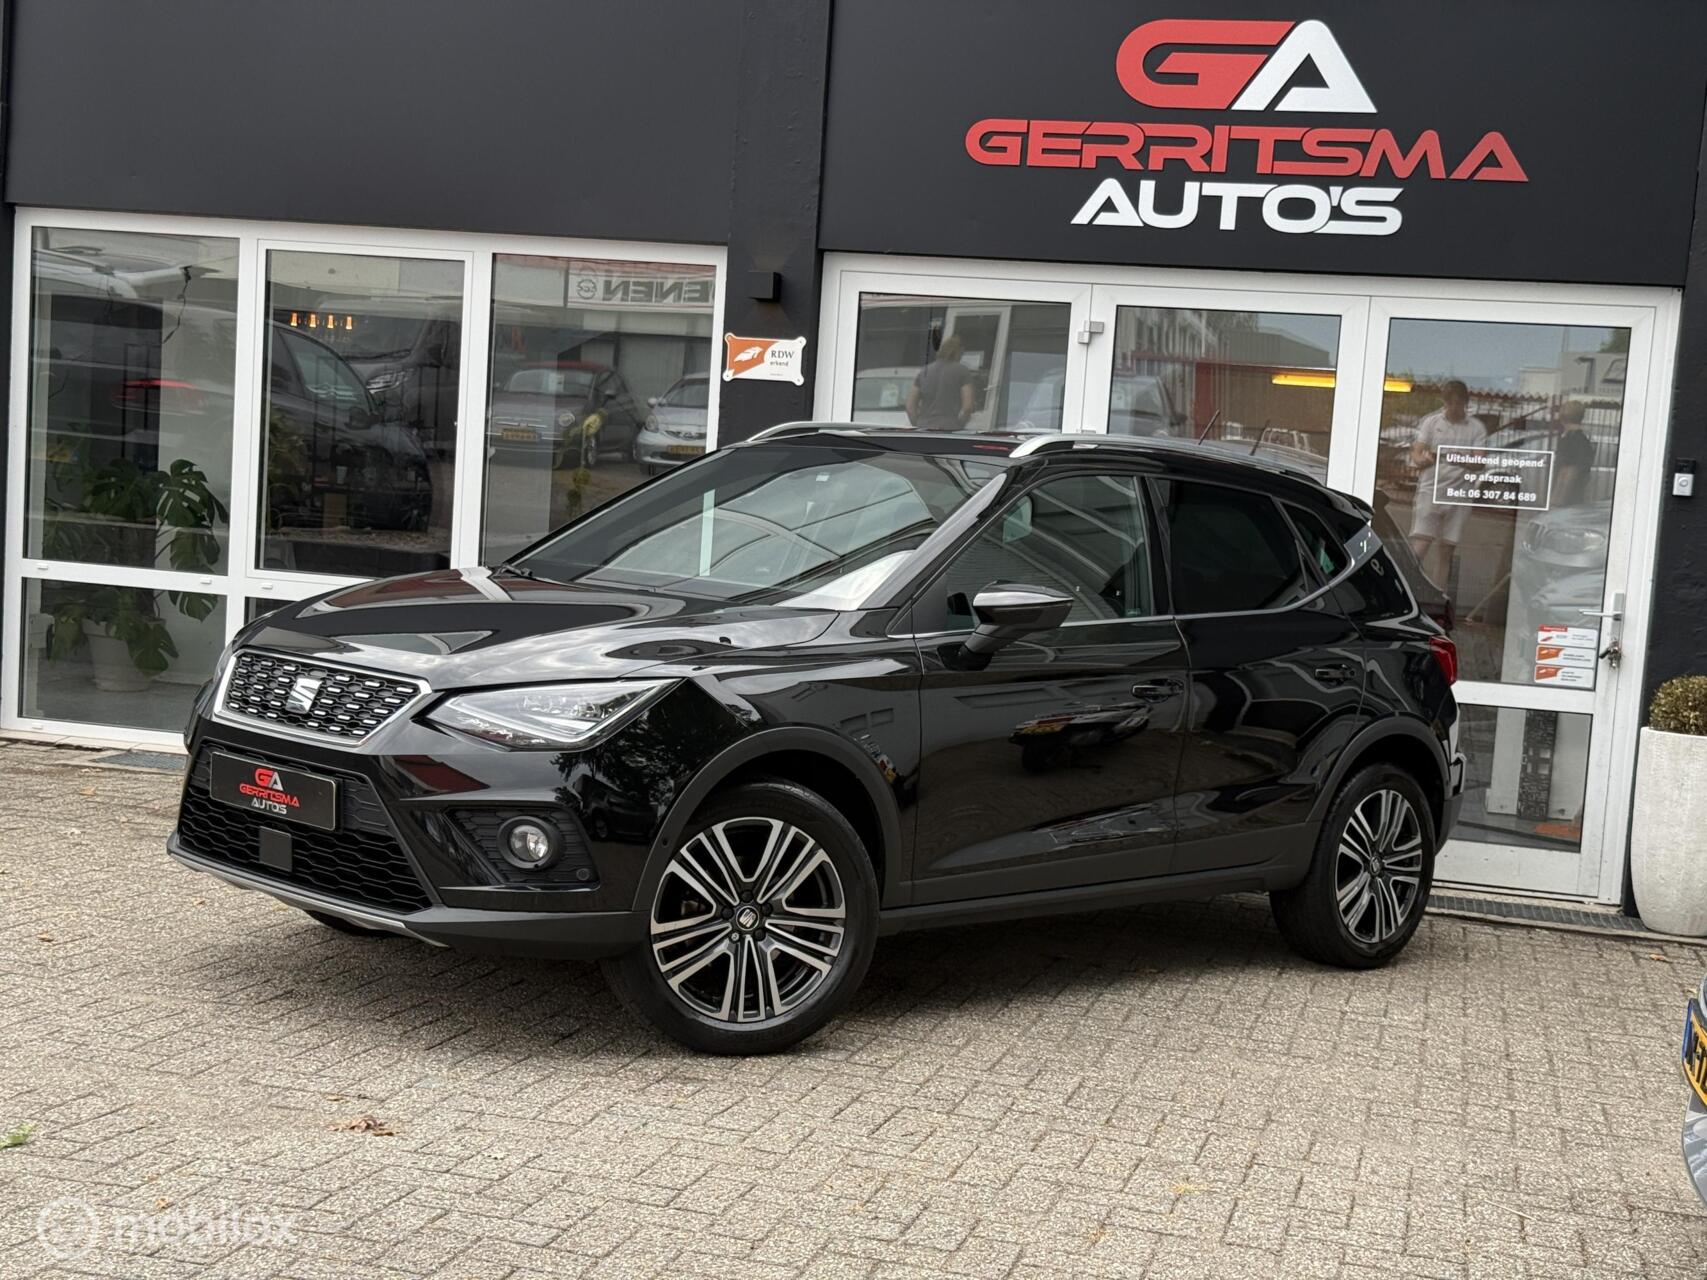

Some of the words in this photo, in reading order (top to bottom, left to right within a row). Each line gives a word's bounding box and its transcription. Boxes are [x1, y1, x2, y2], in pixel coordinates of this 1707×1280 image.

[1116, 19, 1378, 113] GA
[965, 118, 1529, 182] GERRITSMA
[1070, 177, 1404, 236] AUTO'S
[771, 350, 795, 359] RDW
[1446, 453, 1499, 465] Uitsluitend
[1502, 457, 1544, 468] geopend
[1464, 473, 1476, 482] op
[1478, 473, 1522, 484] afspraak
[1447, 488, 1466, 497] Bel:
[1468, 490, 1480, 498] 06
[1482, 490, 1500, 499] 307
[1503, 491, 1515, 500] 84
[1518, 492, 1536, 502] 689
[255, 768, 284, 791] GA
[240, 783, 300, 807] GERRITSMA
